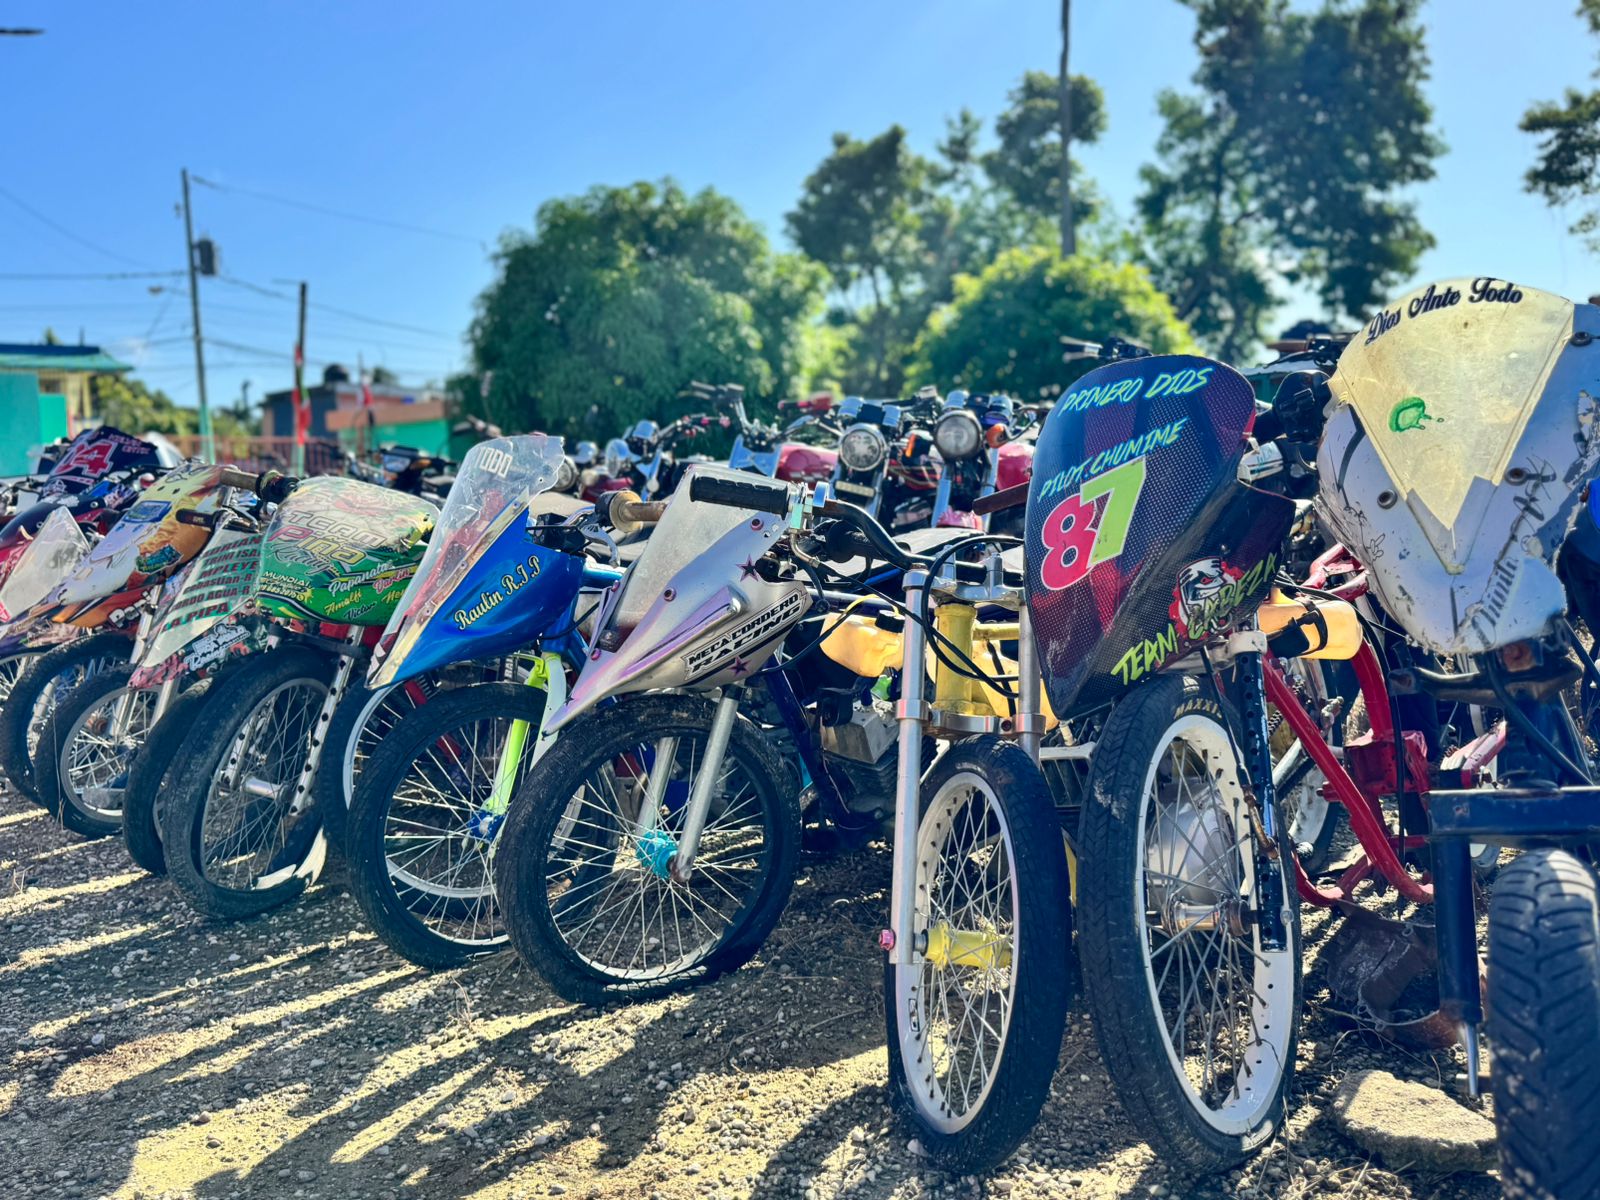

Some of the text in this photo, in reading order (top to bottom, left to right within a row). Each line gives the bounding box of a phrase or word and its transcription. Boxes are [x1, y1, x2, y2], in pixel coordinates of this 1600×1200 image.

[1364, 277, 1523, 346] Dios Ante Todo
[1057, 367, 1213, 417] PRIMERO DIOS
[1041, 454, 1146, 591] 87
[186, 602, 230, 623] PIPA
[454, 591, 504, 631] Raulin
[691, 606, 801, 674] RACING
[1110, 623, 1179, 686] TEAM
